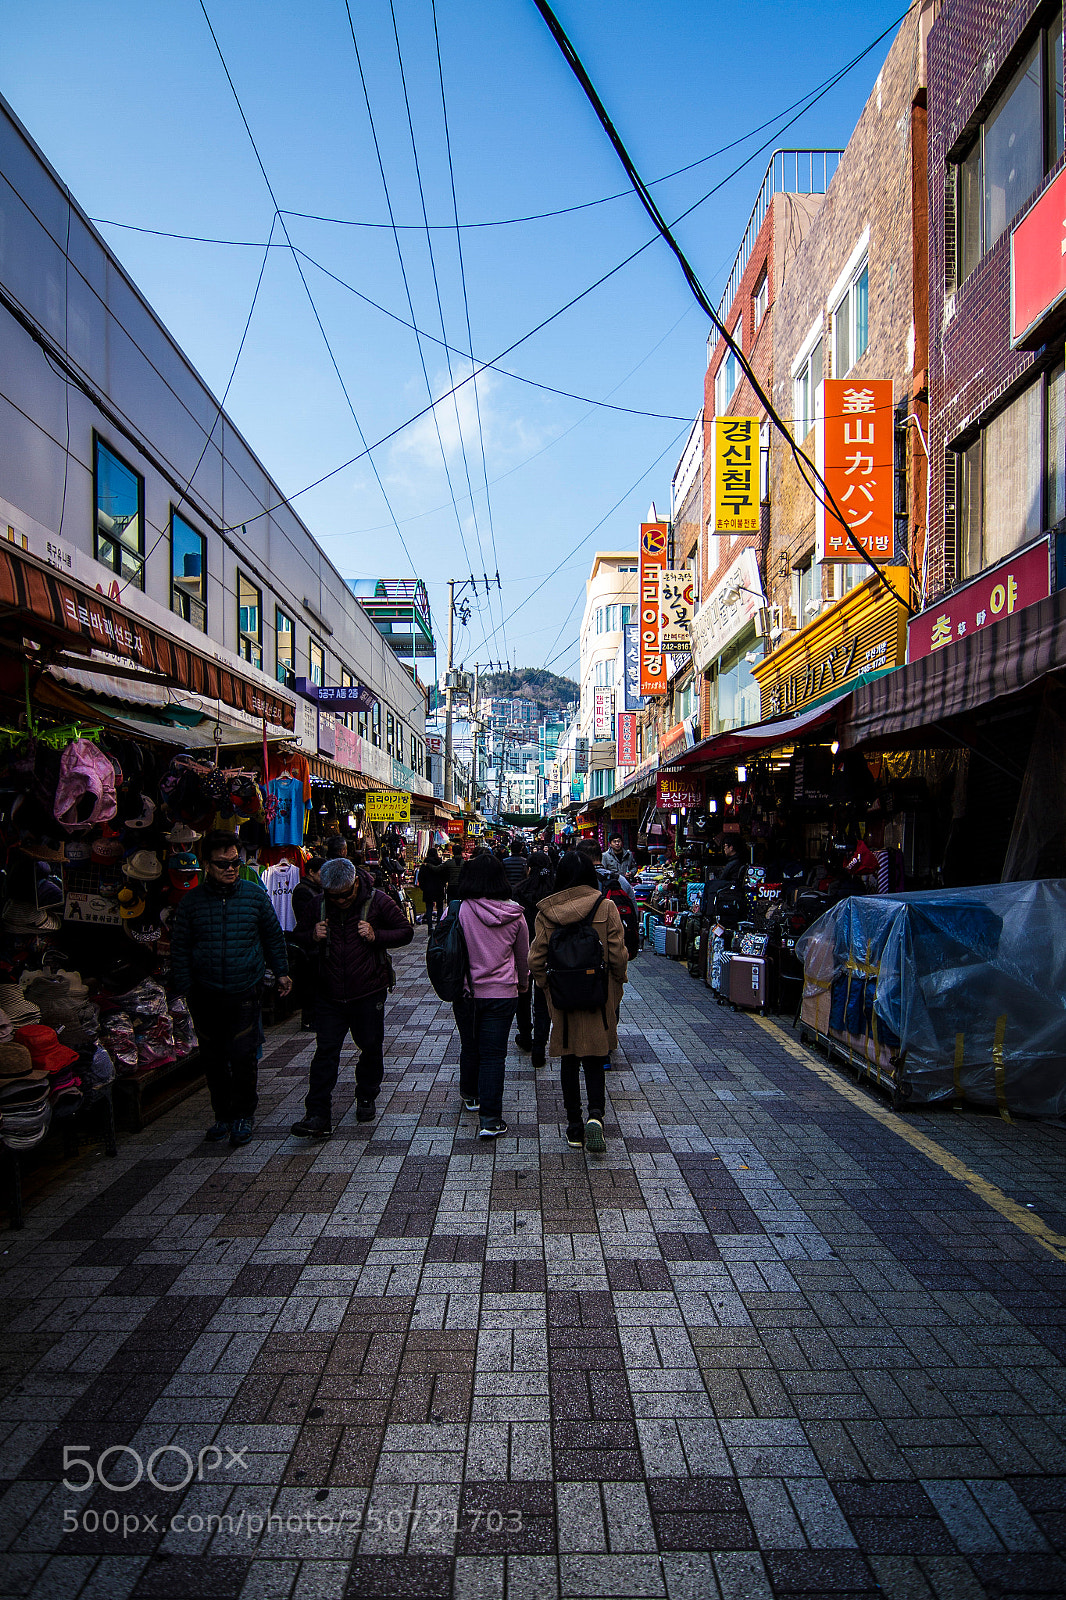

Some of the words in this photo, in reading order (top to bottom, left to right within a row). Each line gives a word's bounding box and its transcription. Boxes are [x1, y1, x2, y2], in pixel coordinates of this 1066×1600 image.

[720, 420, 753, 515] 경신침구
[840, 388, 877, 528] 釜山カバン
[65, 597, 144, 656] 크로바패션모자
[643, 563, 663, 675] 코리아안경
[662, 584, 691, 631] 한복
[930, 614, 953, 651] 초
[989, 574, 1018, 614] 야
[318, 688, 335, 699] 5공구
[595, 695, 604, 727] 챔피언
[367, 795, 409, 804] 코리아가방
[660, 792, 701, 803] 부산가방
[469, 822, 481, 835] 이불
[758, 886, 782, 901] Supr
